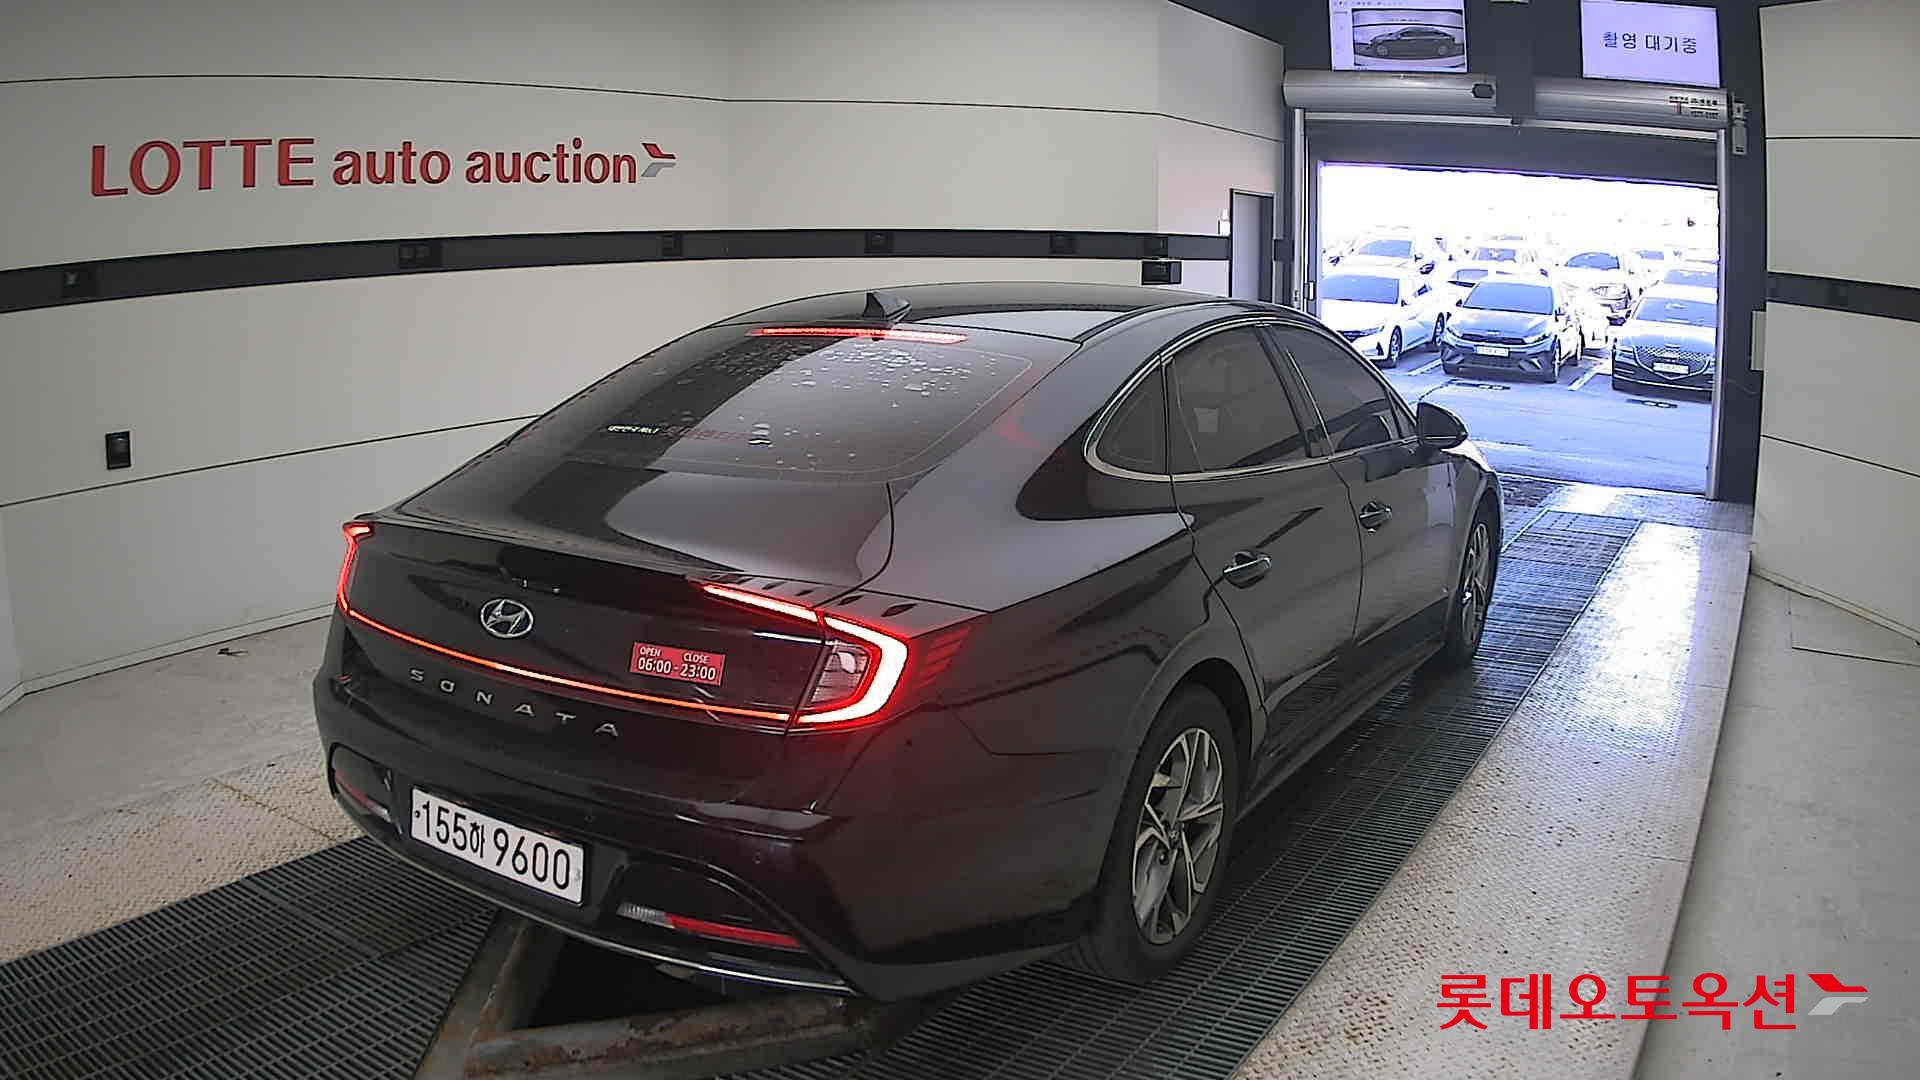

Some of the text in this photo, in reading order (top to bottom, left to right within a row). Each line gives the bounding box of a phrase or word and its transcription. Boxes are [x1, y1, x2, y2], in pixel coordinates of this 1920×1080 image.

[1645, 34, 1697, 54] 대기중
[90, 138, 637, 197] LOTTE auto auction
[639, 646, 661, 657] OPEN
[683, 652, 710, 664] CLOSE
[638, 657, 672, 674] 06:00
[679, 663, 716, 680] 23:00
[409, 668, 619, 737] SONATA
[422, 800, 571, 890] 155하 9600
